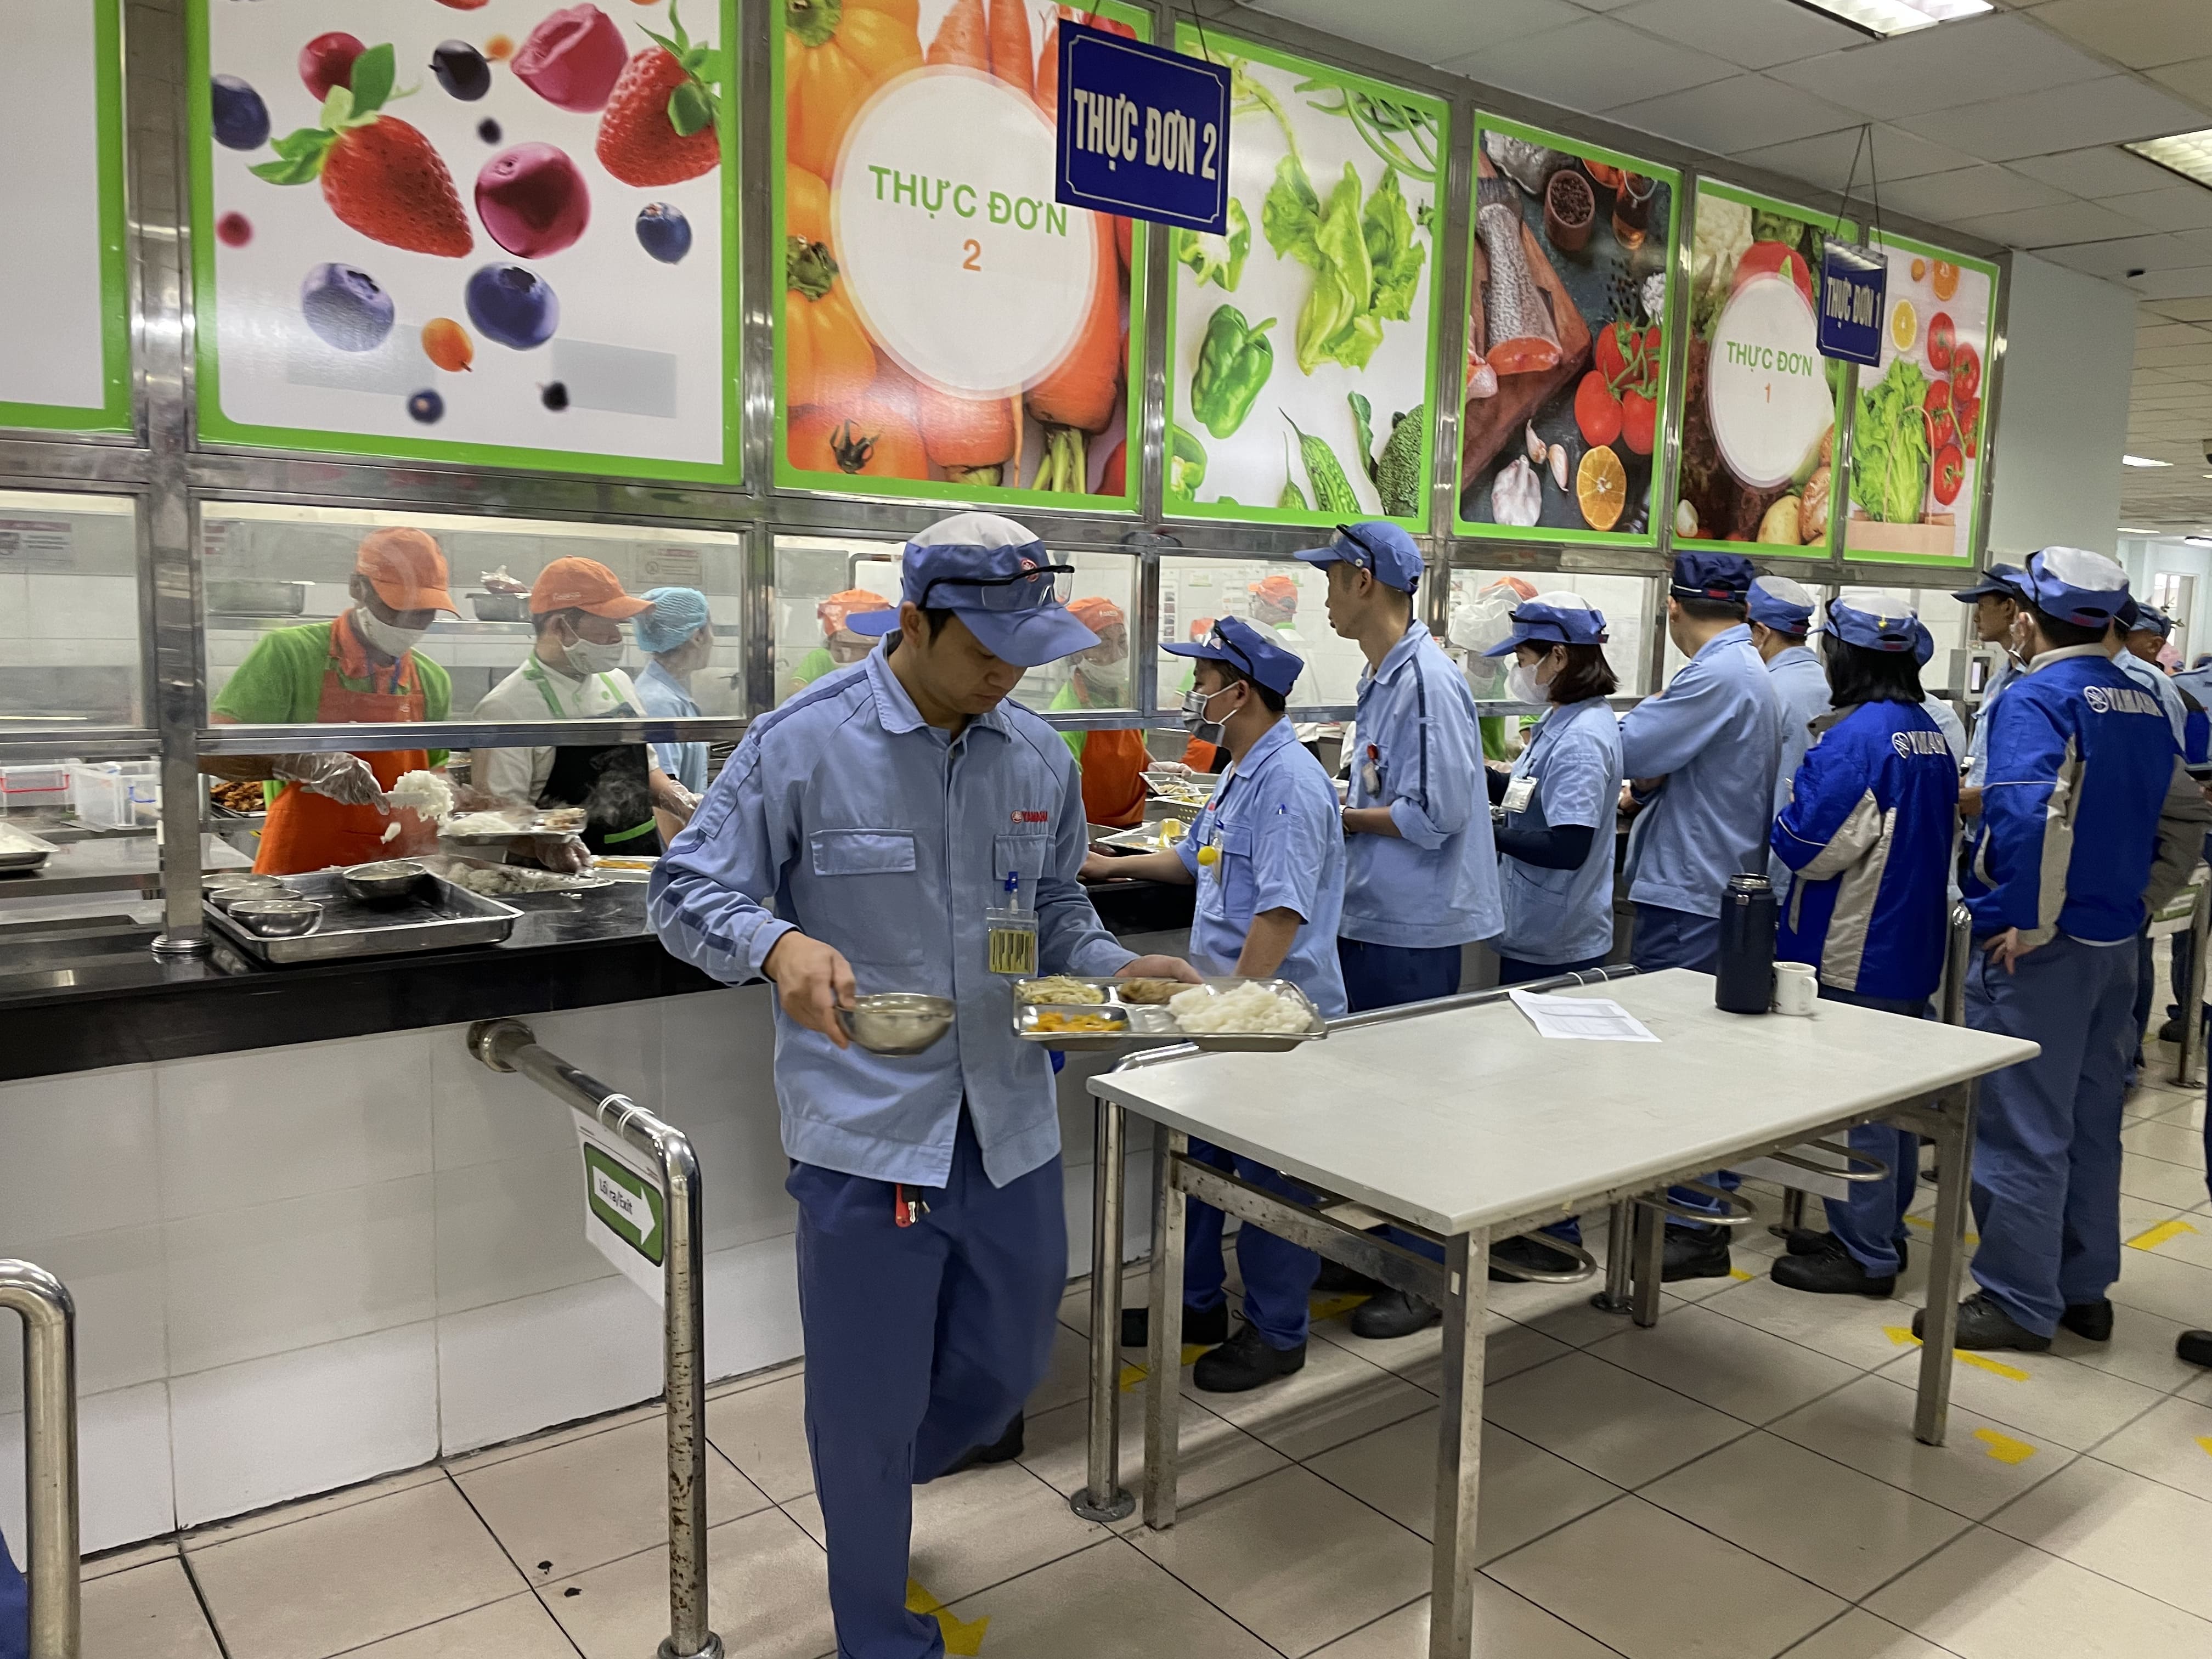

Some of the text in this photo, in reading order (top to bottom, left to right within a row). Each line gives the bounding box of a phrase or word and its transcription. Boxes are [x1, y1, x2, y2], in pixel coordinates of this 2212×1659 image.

[1074, 87, 1217, 180] THỰC ĐƠN 2
[868, 165, 1066, 237] THỰC ĐƠN
[962, 238, 981, 272] 2
[1826, 276, 1881, 330] THỰC ĐƠN 1
[1726, 340, 1813, 377] THỰC ĐƠN
[1764, 382, 1771, 404] 1
